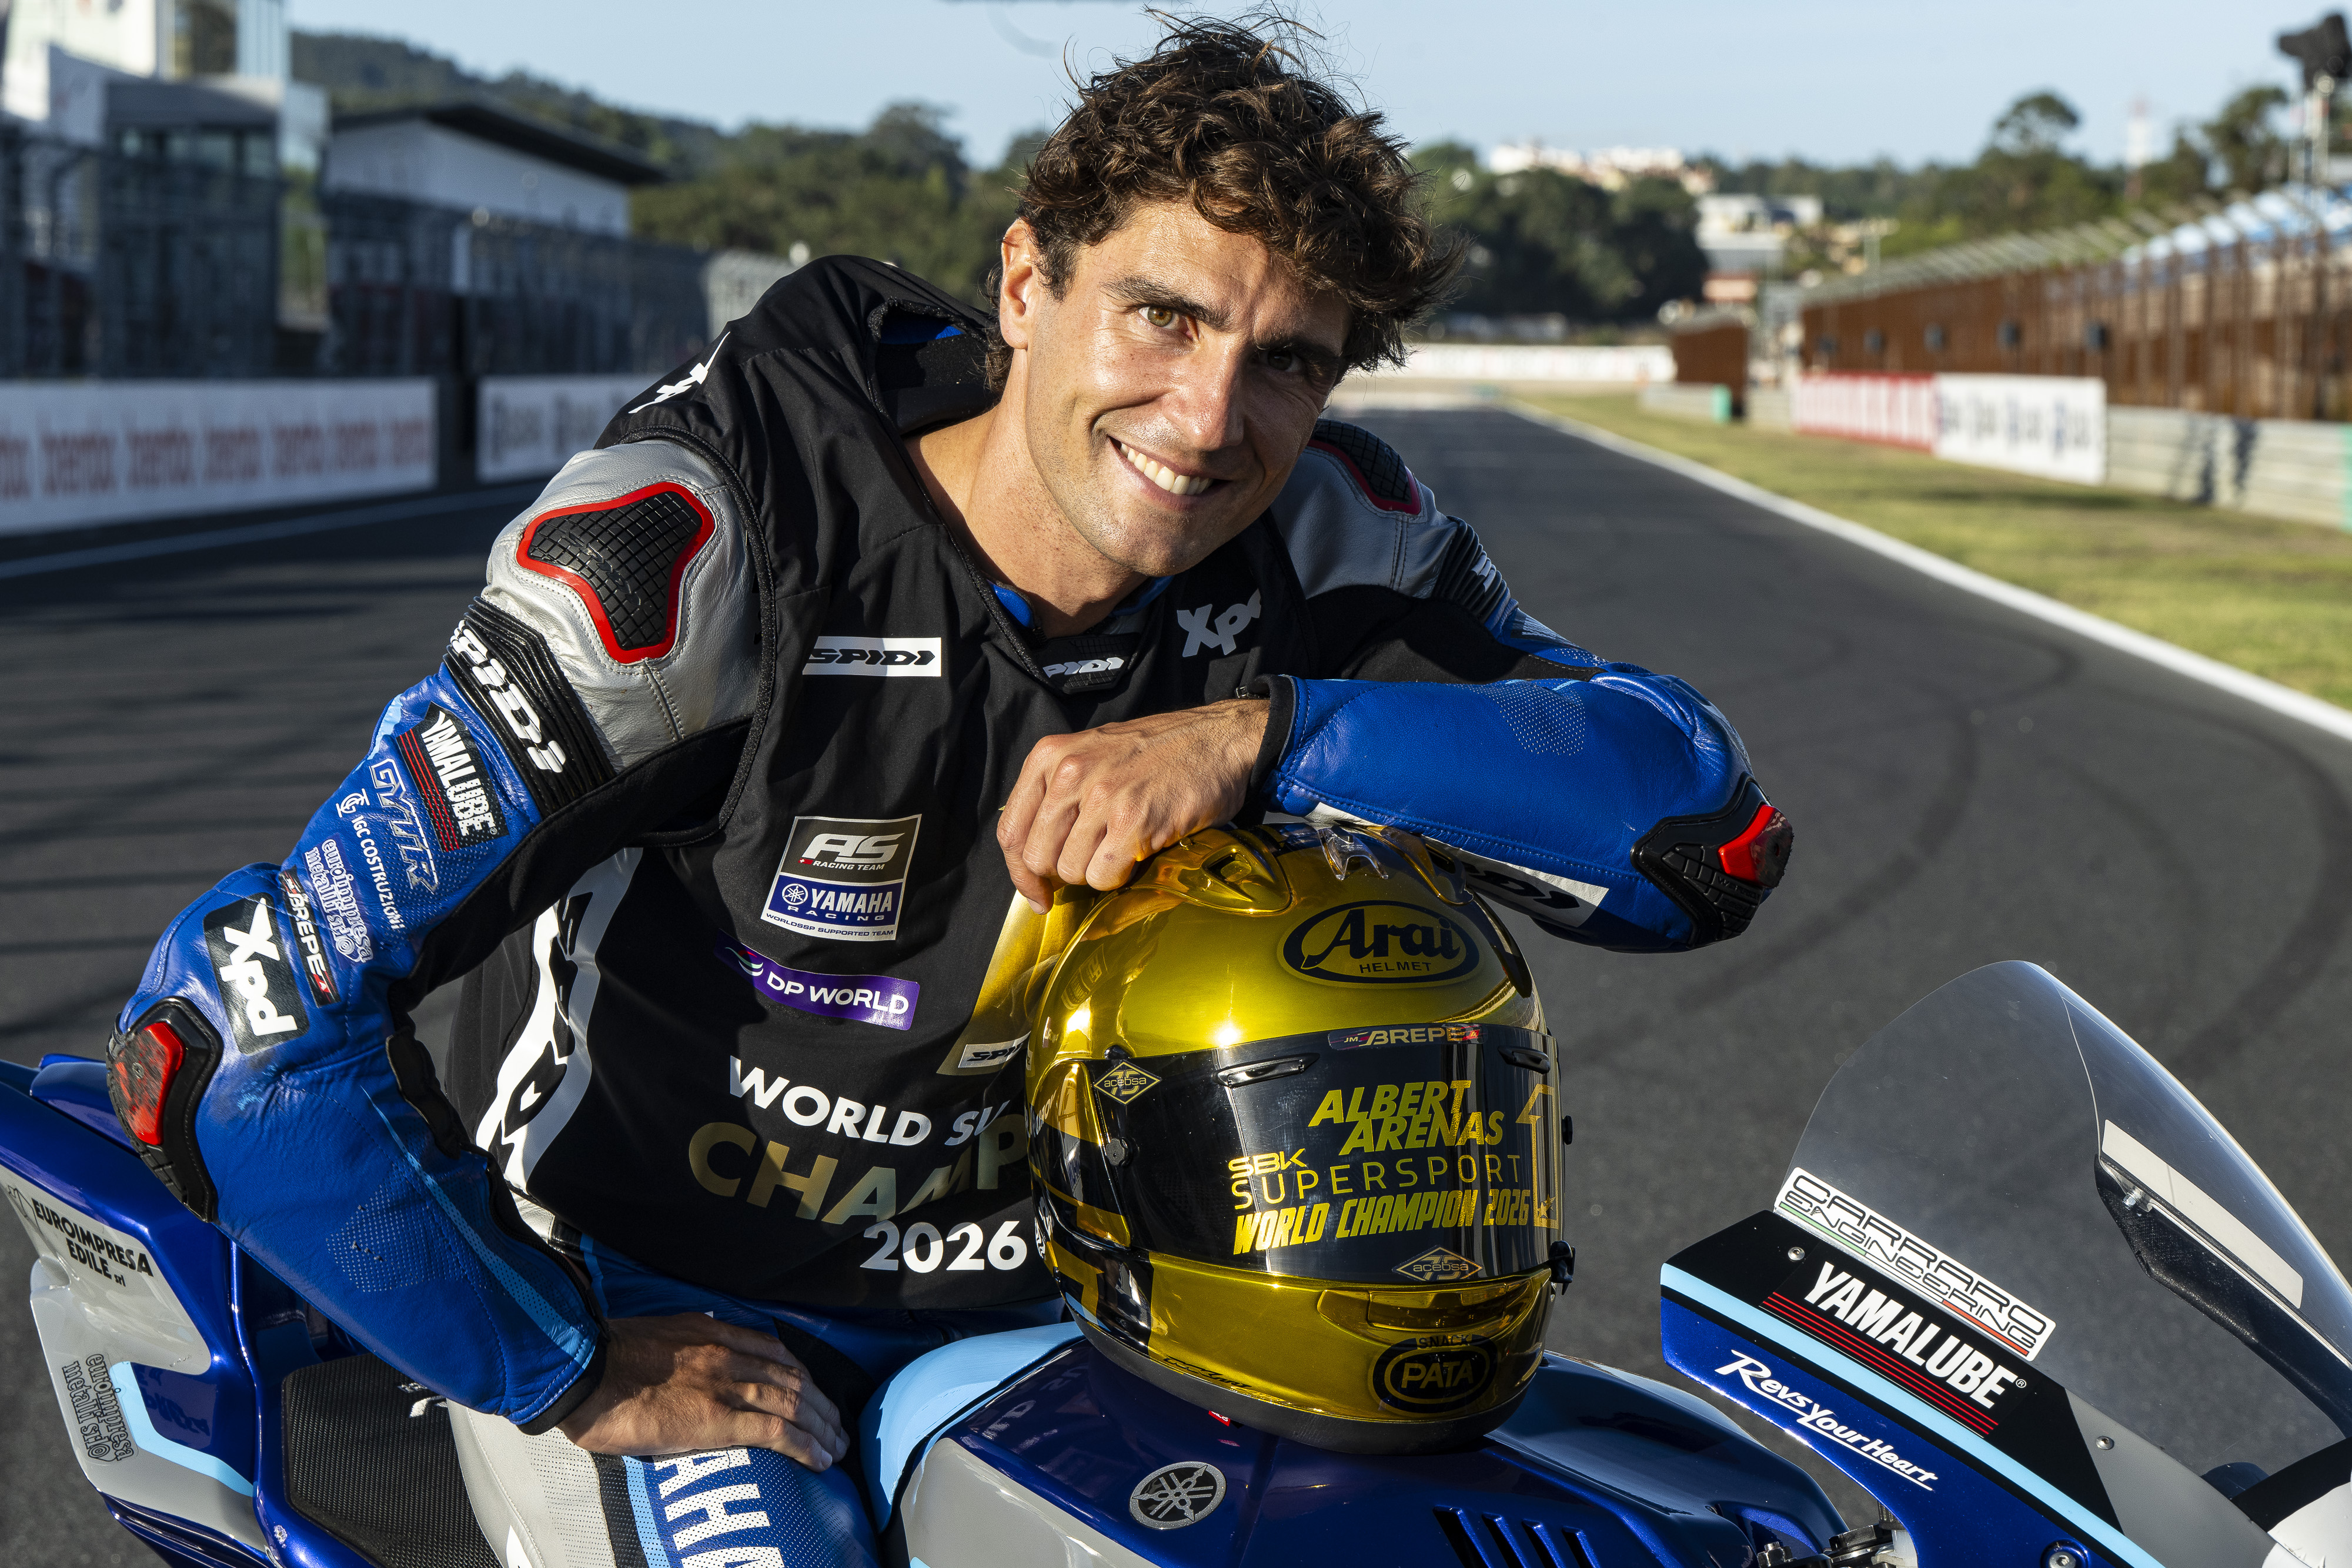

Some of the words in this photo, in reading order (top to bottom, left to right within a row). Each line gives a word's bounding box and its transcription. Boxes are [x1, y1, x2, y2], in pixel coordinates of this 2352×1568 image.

[807, 648, 936, 666] SPIDI
[1043, 657, 1124, 677] PIDI
[421, 710, 496, 837] YAMALUBE
[352, 815, 370, 838] IGC
[801, 833, 905, 864] AS
[360, 838, 406, 930] COSTRUZIONI
[813, 860, 854, 870] RACING
[766, 913, 816, 930] WORLDSSP
[818, 927, 869, 937] SUPPORTED
[787, 905, 884, 921] RACING
[811, 888, 893, 913] YAMAHA
[288, 892, 326, 976] BREPE
[1301, 908, 1461, 969] Arai
[219, 898, 297, 1036] Xpd
[1359, 961, 1431, 974] HELMET
[766, 971, 804, 995] DP
[810, 985, 909, 1015] WORLD
[1365, 1027, 1465, 1045] BREPE
[730, 1055, 932, 1146] WORLD
[1104, 1076, 1147, 1088] acebsa
[1308, 1079, 1472, 1127] ALBERT
[1339, 1110, 1504, 1155] ARENAS
[689, 1114, 1028, 1225] CHAMP
[1228, 1148, 1308, 1179] SBK
[1231, 1154, 1521, 1210] SUPERSPORT
[32, 1198, 154, 1278] EUROIMPRESA
[860, 1220, 1027, 1273] 2026
[1234, 1202, 1330, 1255] WORLD
[1336, 1189, 1478, 1238] CHAMPION
[1484, 1189, 1531, 1228] 2026
[66, 1238, 112, 1281] EDILE
[114, 1274, 126, 1288] srl
[1413, 1262, 1468, 1272] acebsa
[1783, 1191, 2039, 1350] ENGINEERING
[1793, 1175, 2047, 1336] CARRARO
[1419, 1334, 1470, 1349] SNACK
[1803, 1261, 2019, 1409] YAMALUBE
[61, 1360, 102, 1425] metalli
[1401, 1359, 1474, 1389] PATA
[86, 1353, 135, 1462] euroimpresa
[1714, 1349, 1810, 1411] Revs
[1860, 1438, 1939, 1483] Heart
